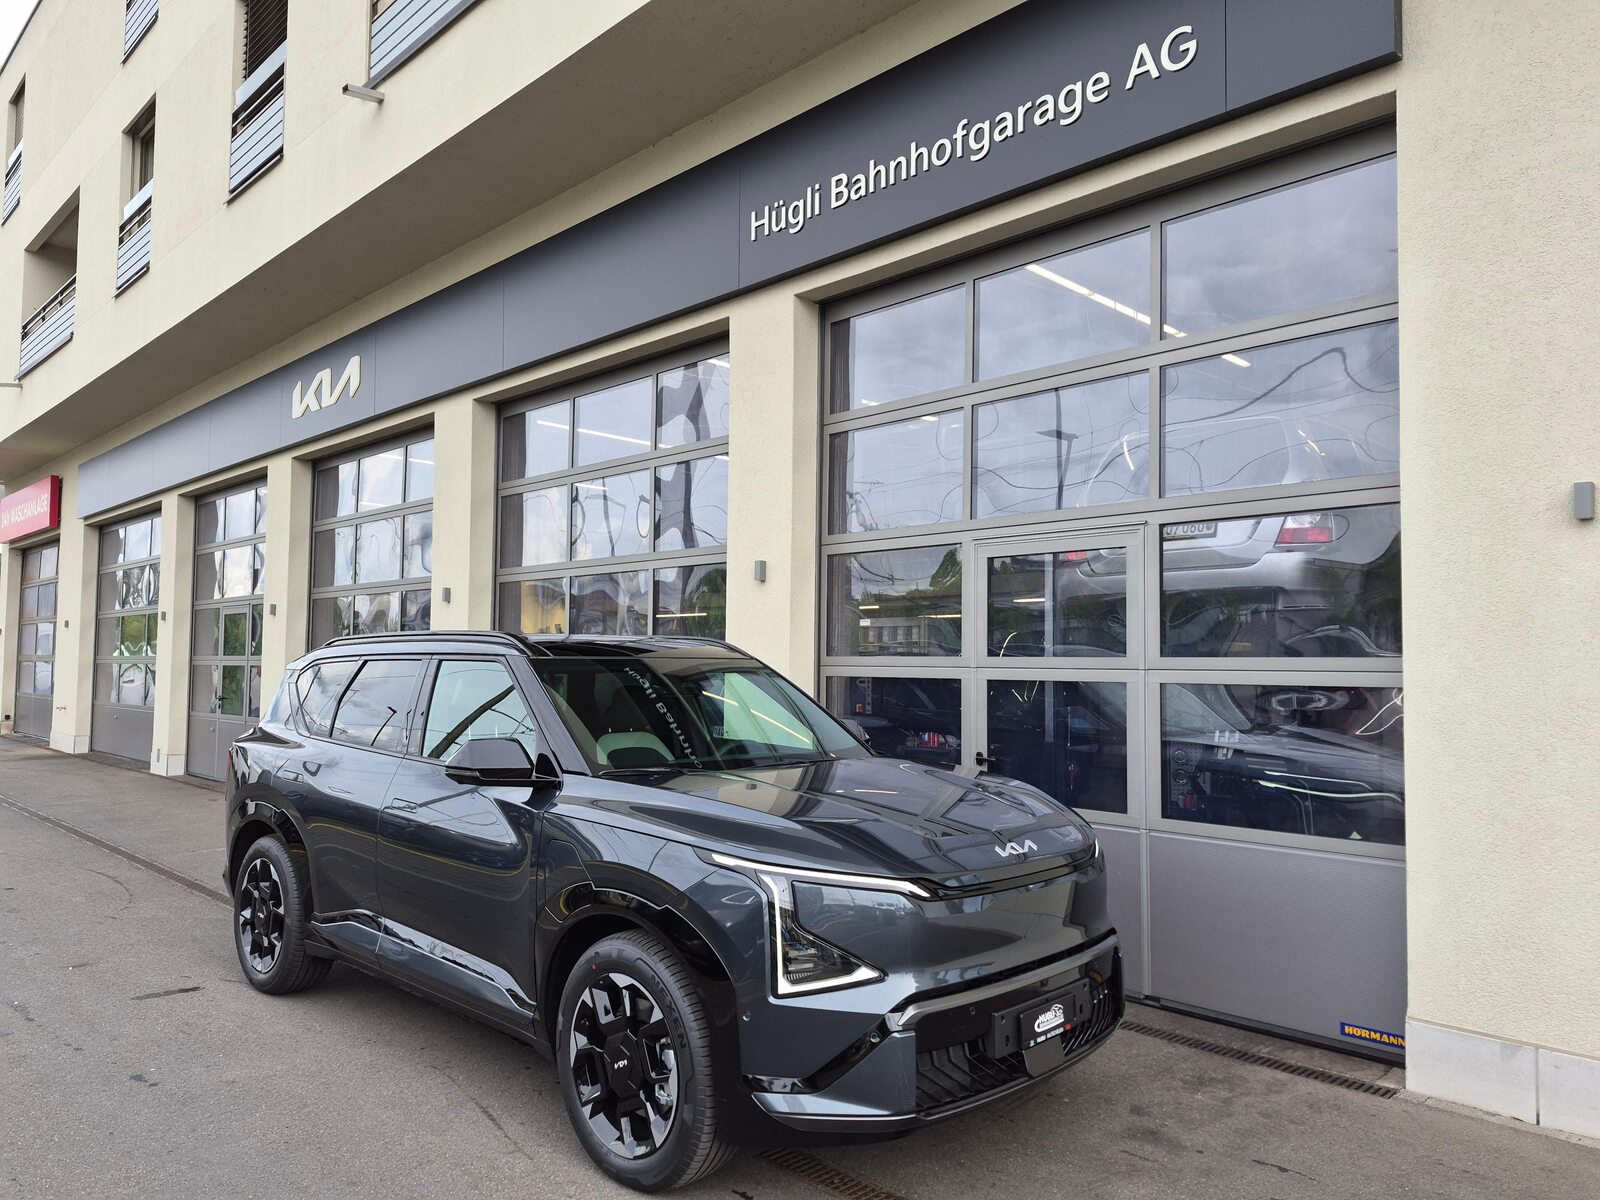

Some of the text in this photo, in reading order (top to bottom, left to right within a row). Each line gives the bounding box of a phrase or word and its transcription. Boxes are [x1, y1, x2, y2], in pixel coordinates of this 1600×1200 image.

[749, 25, 1198, 241] Hügli Bahnhofgarage AG
[292, 355, 361, 419] KIA
[10, 493, 48, 524] WASCHANLAGE
[994, 839, 1038, 858] KIA
